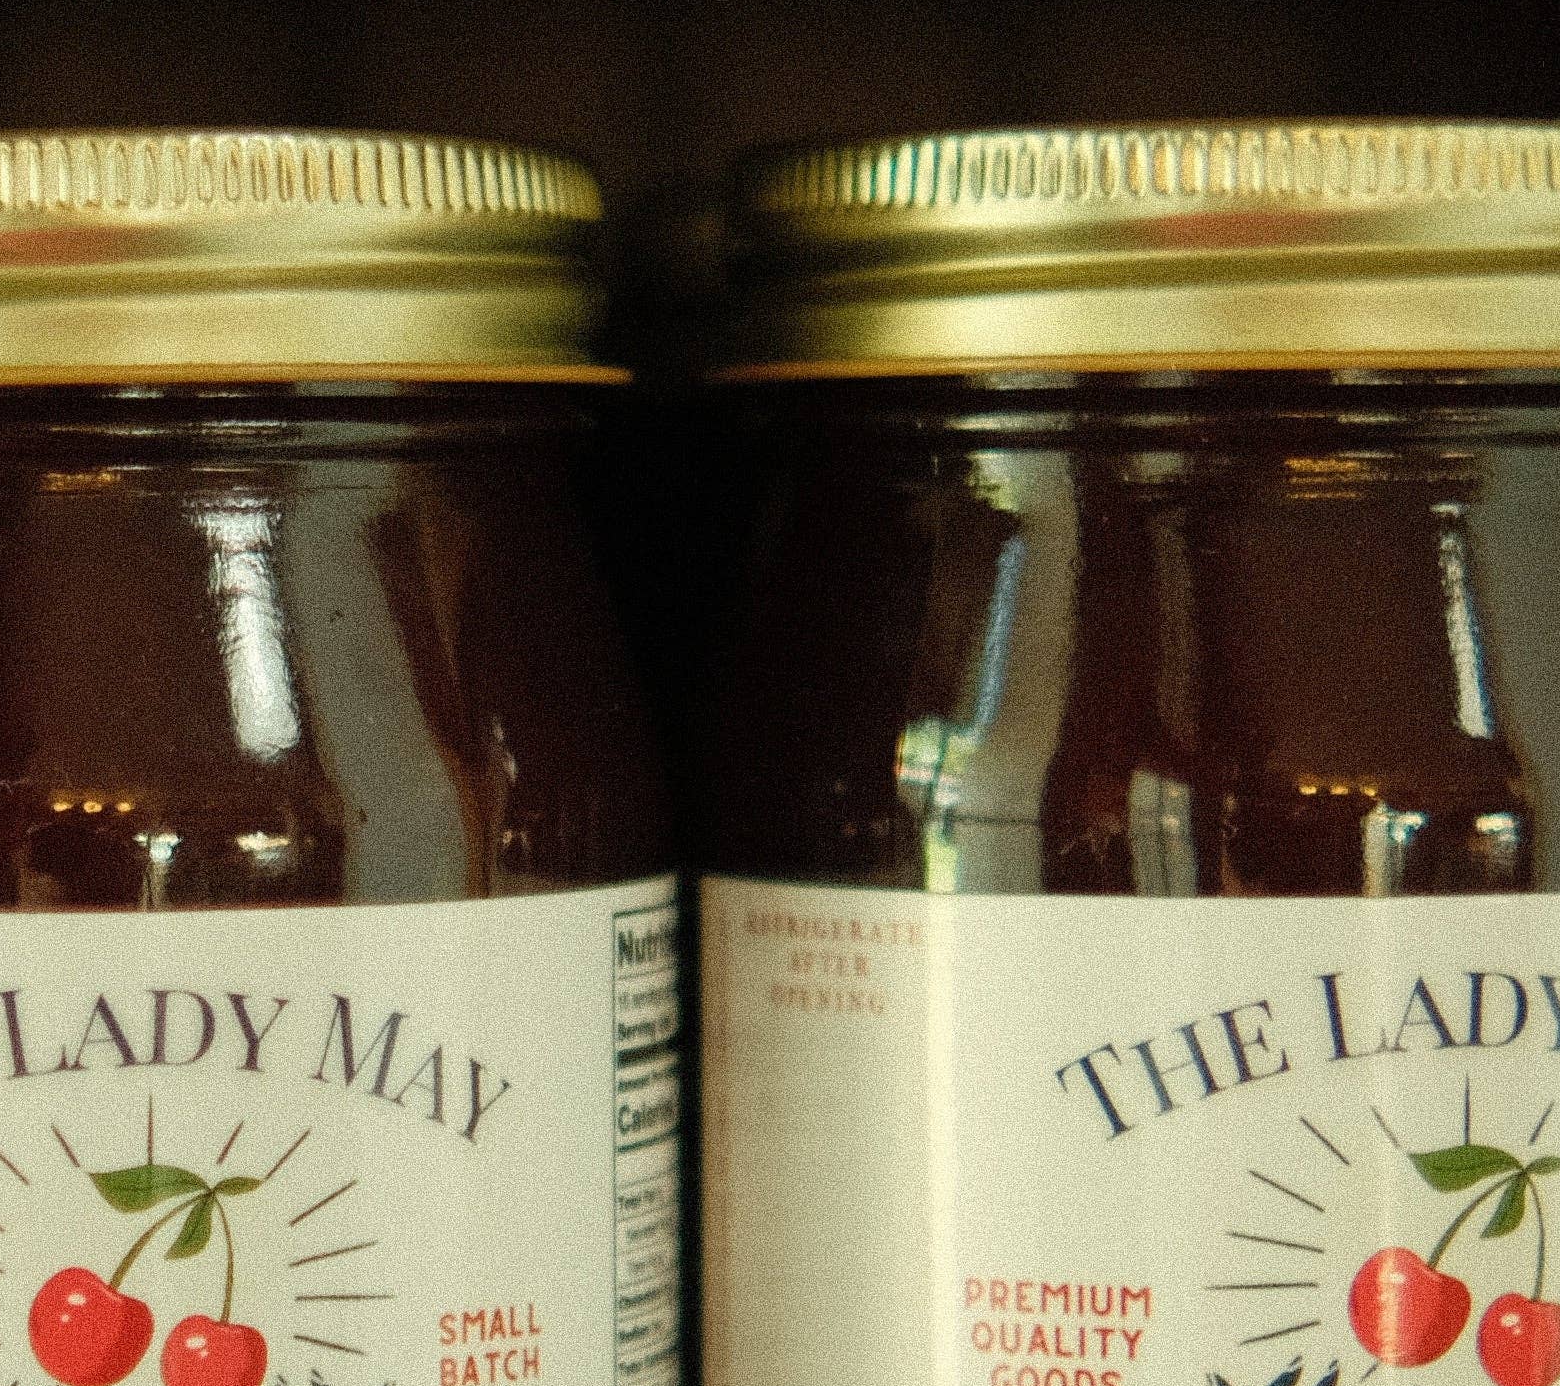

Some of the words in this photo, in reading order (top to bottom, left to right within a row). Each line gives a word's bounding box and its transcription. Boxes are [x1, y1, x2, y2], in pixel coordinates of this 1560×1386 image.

[311, 995, 514, 1147] MAY
[1055, 999, 1292, 1140] THE
[964, 1278, 1155, 1320] PREMIUM
[437, 1304, 544, 1346] SMALL
[970, 1320, 1144, 1362] QUALITY
